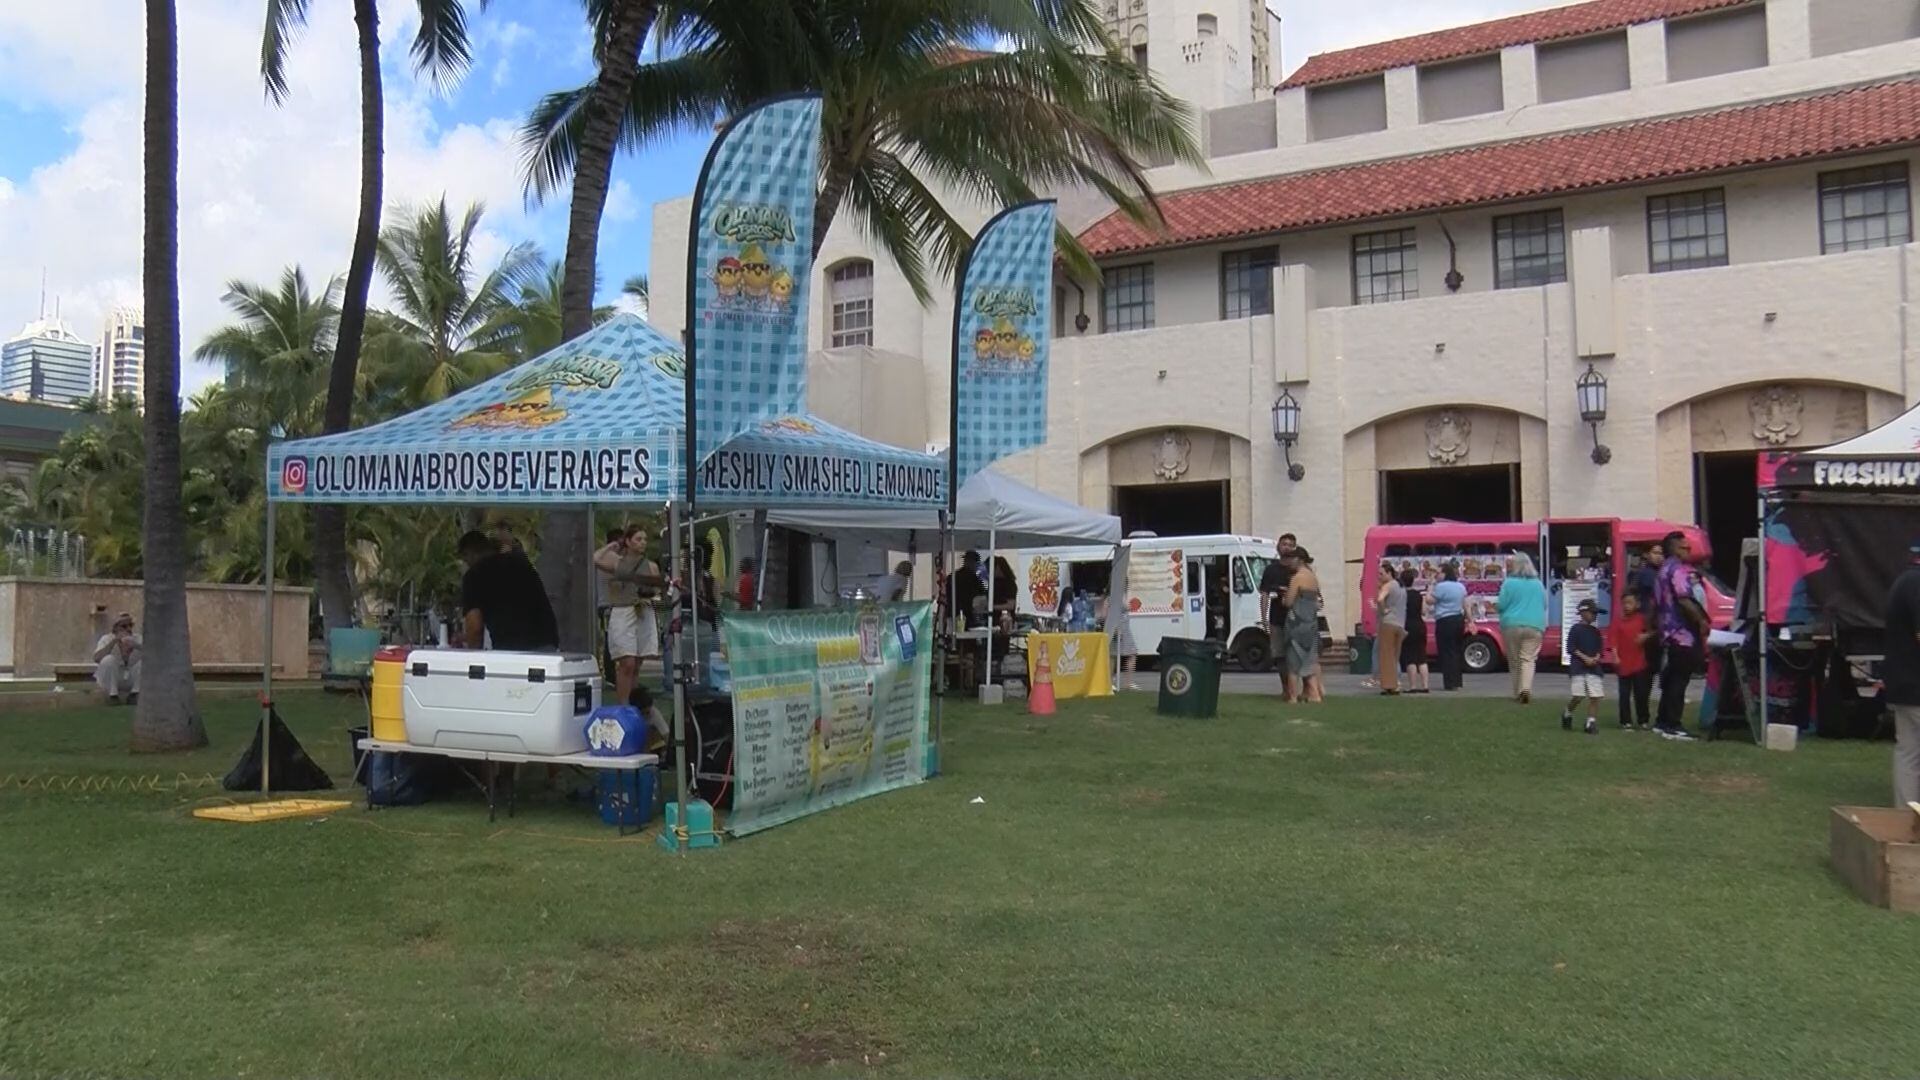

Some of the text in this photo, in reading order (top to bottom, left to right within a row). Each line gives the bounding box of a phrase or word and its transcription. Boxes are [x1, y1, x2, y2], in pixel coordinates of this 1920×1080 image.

[714, 205, 796, 242] OLOMANA
[735, 223, 774, 240] BROS
[314, 448, 651, 492] OLOMANABROSBEVERAGES
[702, 450, 941, 499] RESHLY SMASHED LEMONADE
